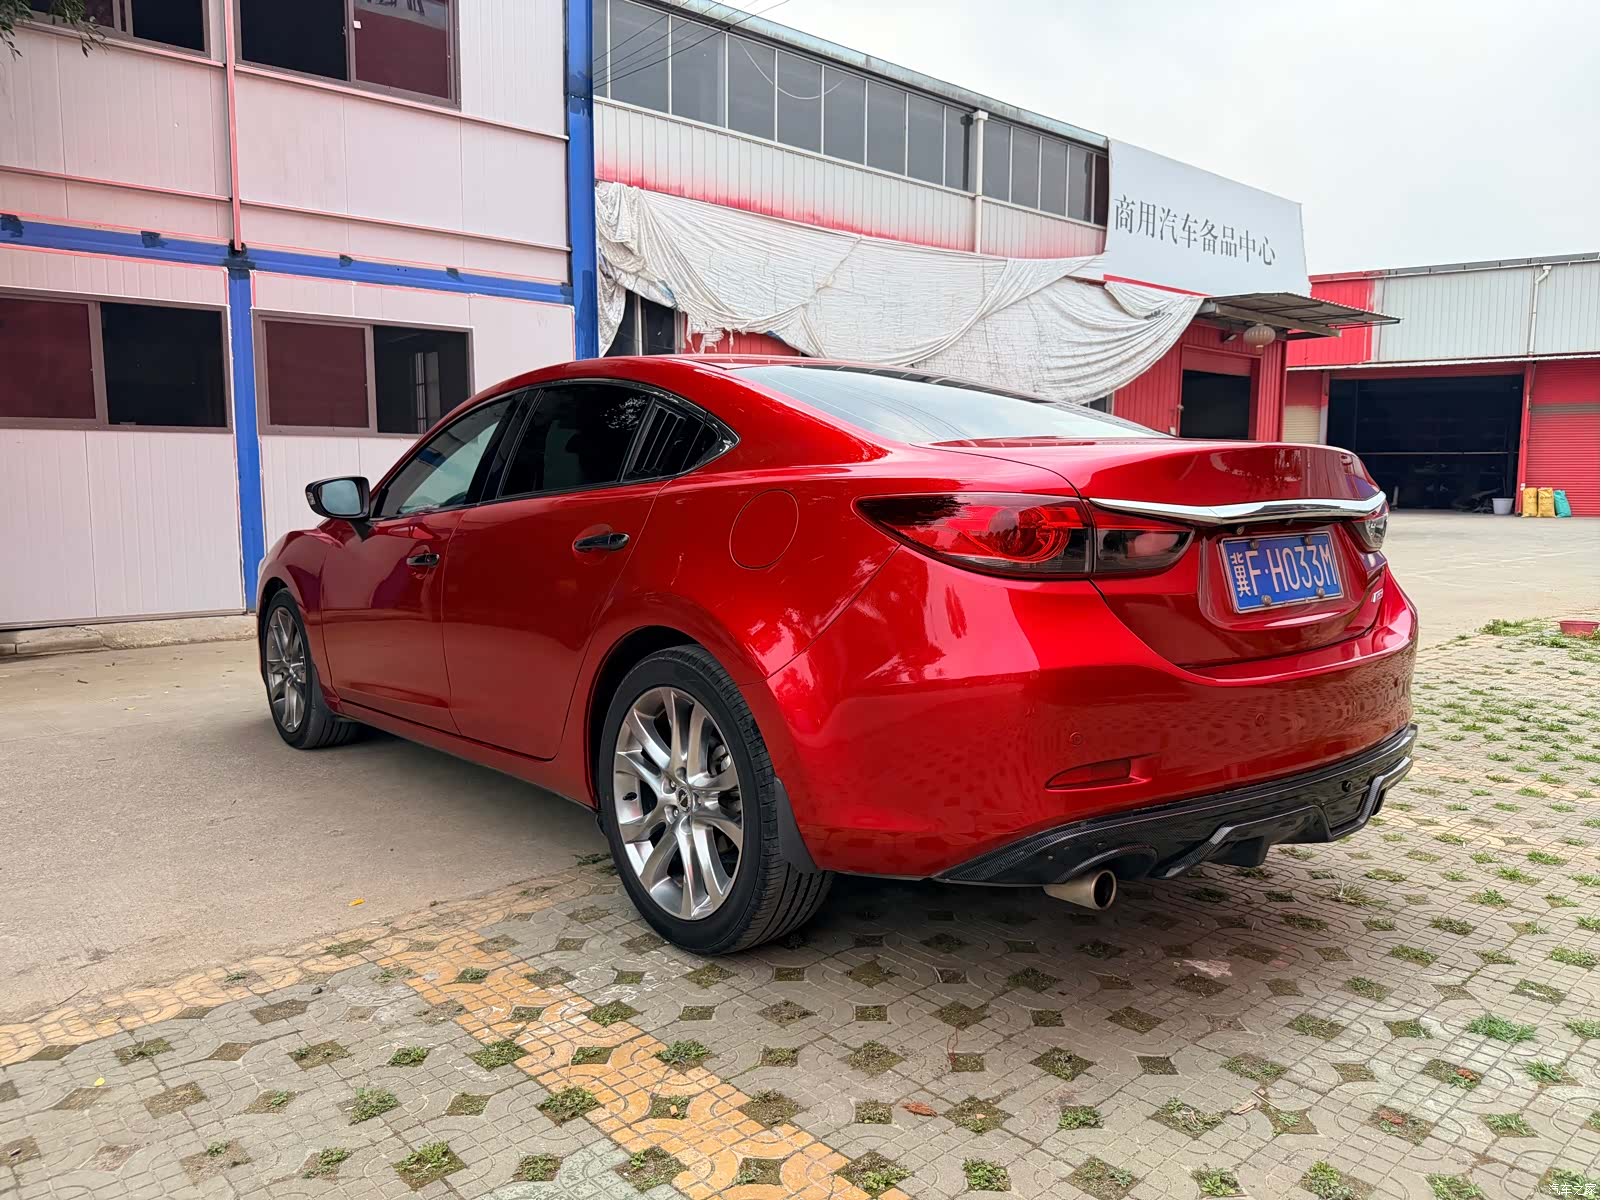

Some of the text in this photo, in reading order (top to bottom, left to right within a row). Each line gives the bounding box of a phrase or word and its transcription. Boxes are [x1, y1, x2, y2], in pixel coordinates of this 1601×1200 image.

[1114, 194, 1275, 266] 商用汽车备品中心
[1230, 544, 1338, 597] 冀F·H033M
